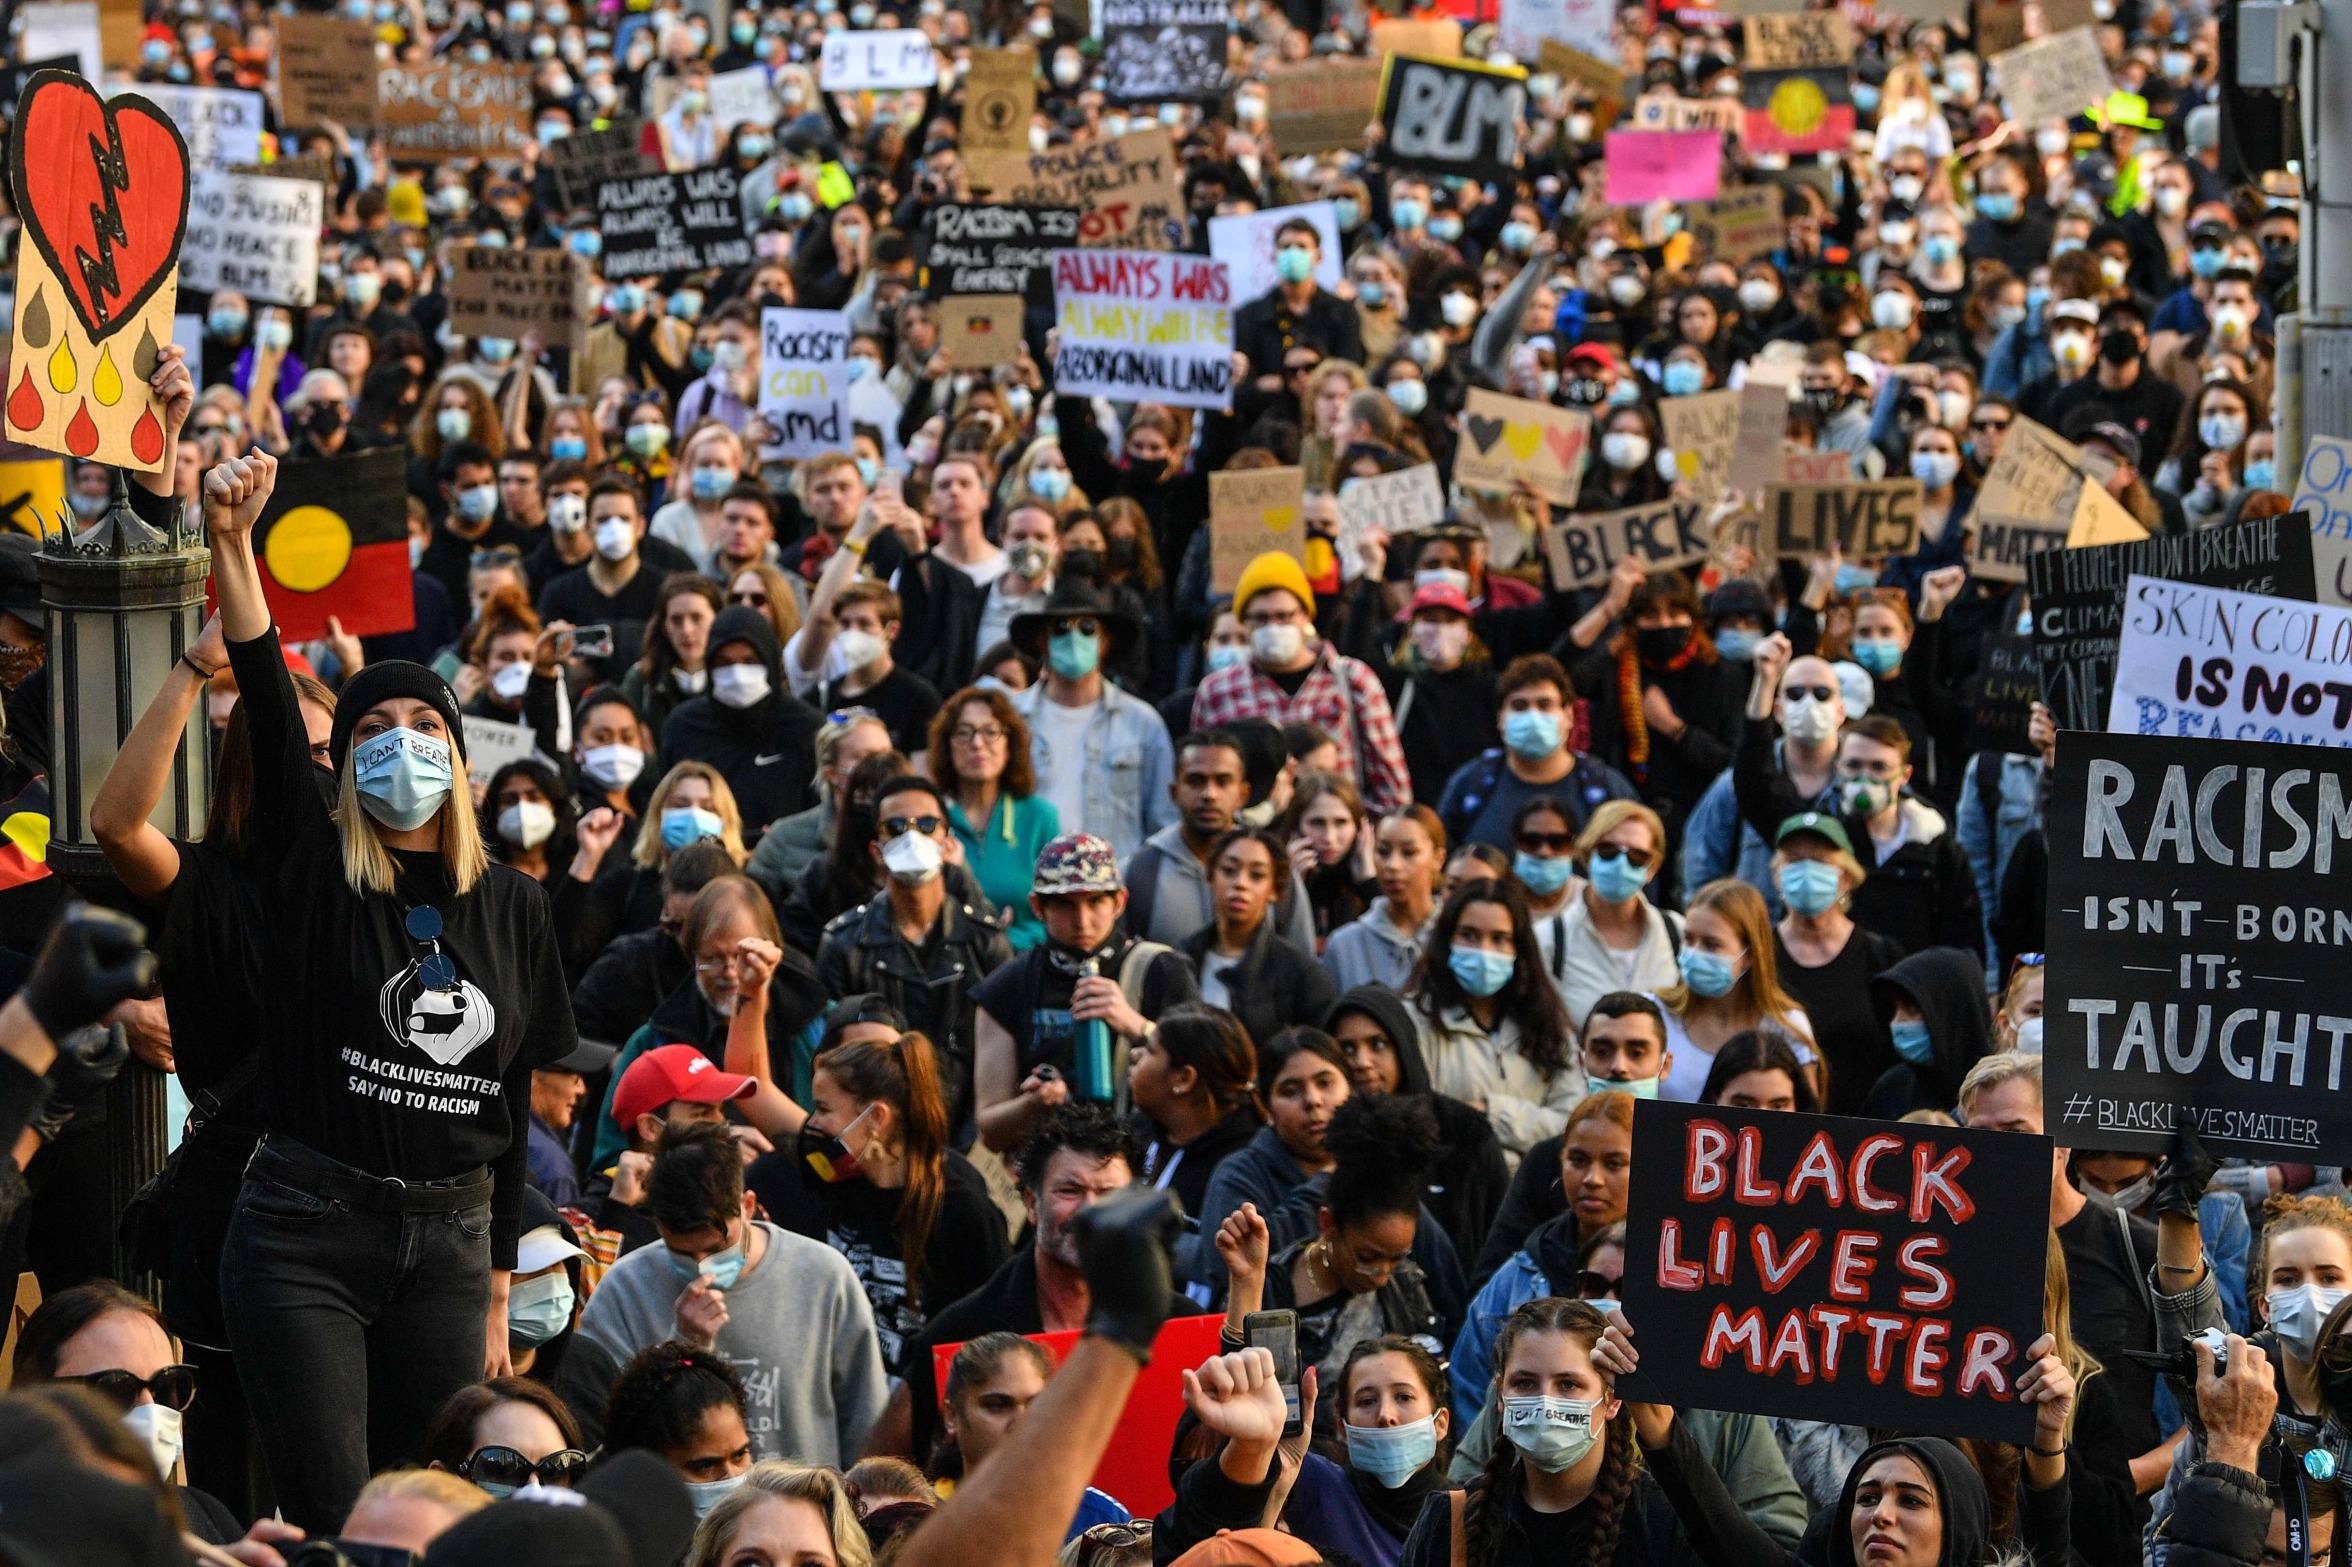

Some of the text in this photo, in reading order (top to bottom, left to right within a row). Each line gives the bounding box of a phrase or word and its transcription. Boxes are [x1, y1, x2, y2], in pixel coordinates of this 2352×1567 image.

[829, 40, 932, 77] BLM
[1391, 62, 1527, 166] BLM
[1028, 141, 1124, 178] POLICE
[682, 166, 738, 200] WAS
[681, 200, 738, 230] WILL
[935, 204, 1079, 241] RACISM IS
[1079, 201, 1131, 239] OT
[222, 231, 298, 263] PEACE
[1057, 254, 1162, 299] ALWAYS
[1171, 258, 1230, 304] WAS
[766, 319, 850, 363] Racism
[768, 369, 828, 398] can
[1171, 355, 1231, 394] LAND
[1563, 503, 1709, 581] BLACK
[1775, 487, 1917, 554] LIVES
[2199, 513, 2282, 575] BREATHE
[2040, 605, 2123, 637] CLIMA
[2133, 584, 2352, 667] SKIN COLO
[2175, 655, 2234, 708] IS
[361, 756, 368, 770] I
[410, 740, 449, 771] BREATHE
[2084, 888, 2352, 947] ISN'T BORN
[2067, 998, 2352, 1091] TAUGHT
[341, 1046, 501, 1097] #BLACKLIVESMATTER
[347, 1075, 481, 1116] SAY NO TO RACISM
[2063, 1091, 2321, 1145] #BLACKLVESMATTER
[1684, 1117, 1976, 1225] BLACK
[1656, 1217, 1955, 1311] LIVES
[1700, 1301, 2016, 1402] MATTER
[1510, 1410, 1514, 1422] I
[1545, 1409, 1591, 1425] BREATHE
[2291, 1518, 2300, 1551] OM-D
